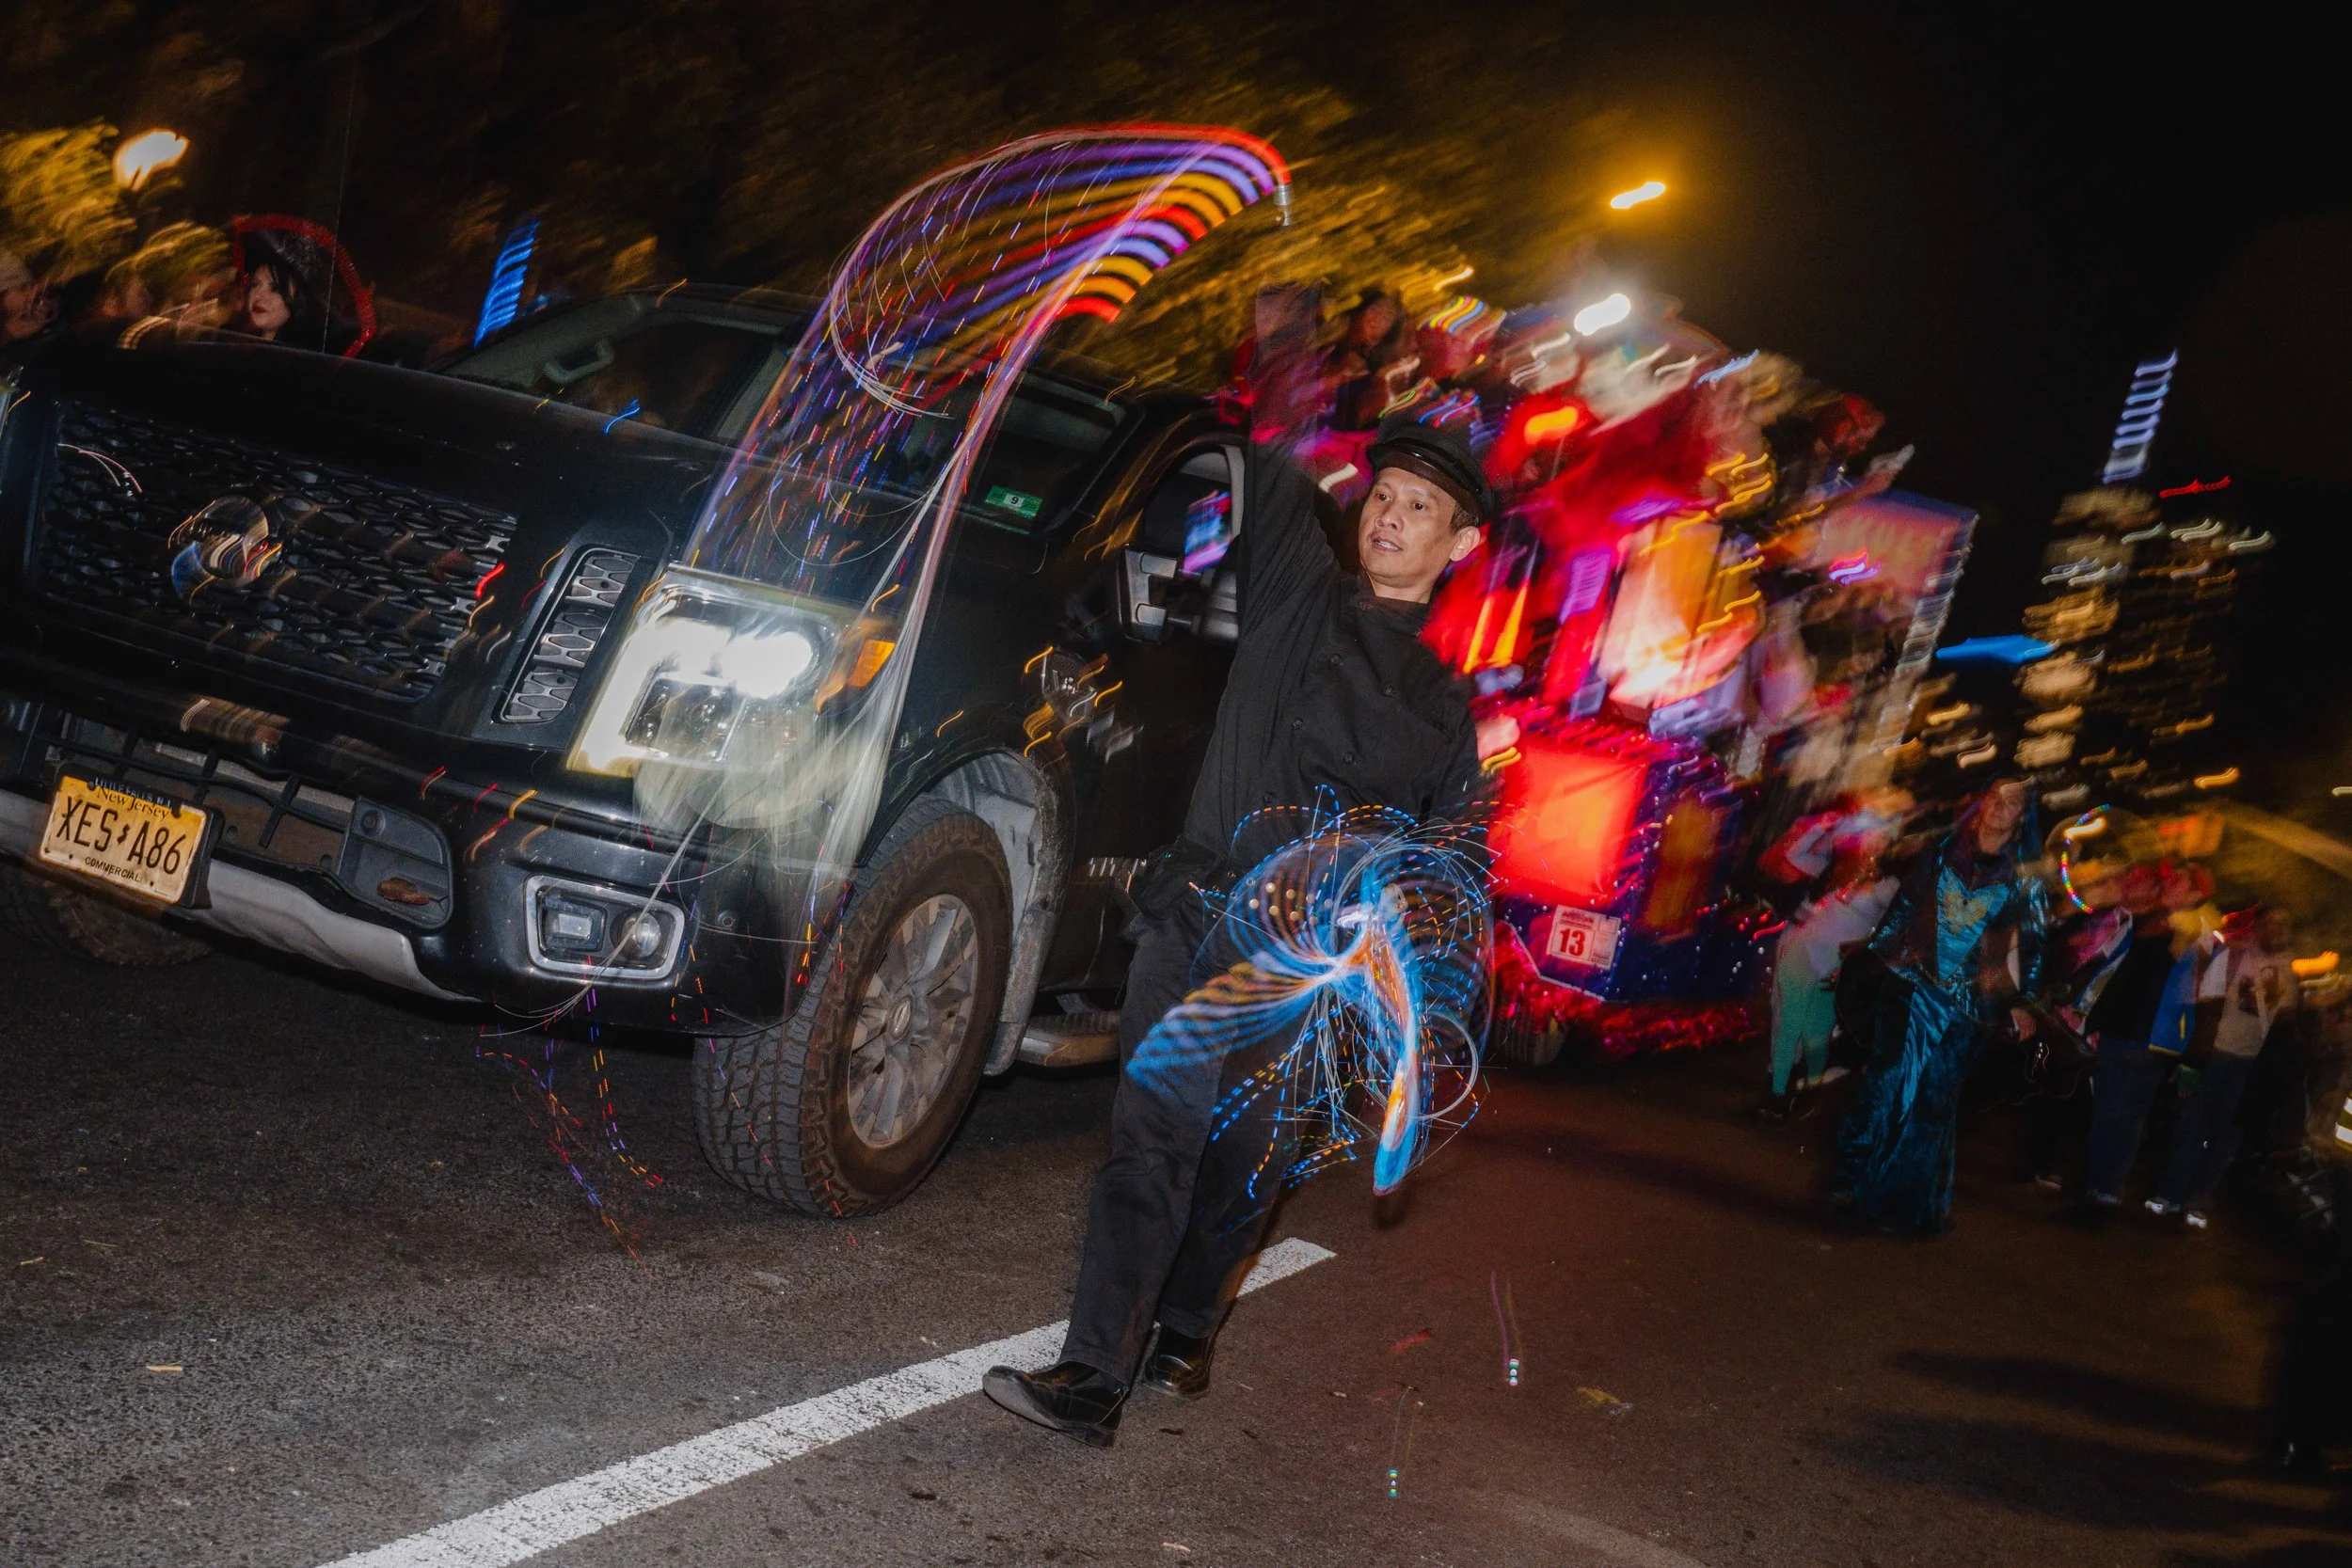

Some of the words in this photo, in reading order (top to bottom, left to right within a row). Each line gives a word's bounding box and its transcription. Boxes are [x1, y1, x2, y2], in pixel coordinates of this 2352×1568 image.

[1010, 497, 1019, 505] 9
[96, 787, 128, 806] New
[127, 797, 170, 821] Jersey
[56, 795, 118, 852] XES
[127, 819, 186, 875] A86
[85, 856, 140, 881] COMMERCIAL
[1560, 927, 1585, 957] 13
